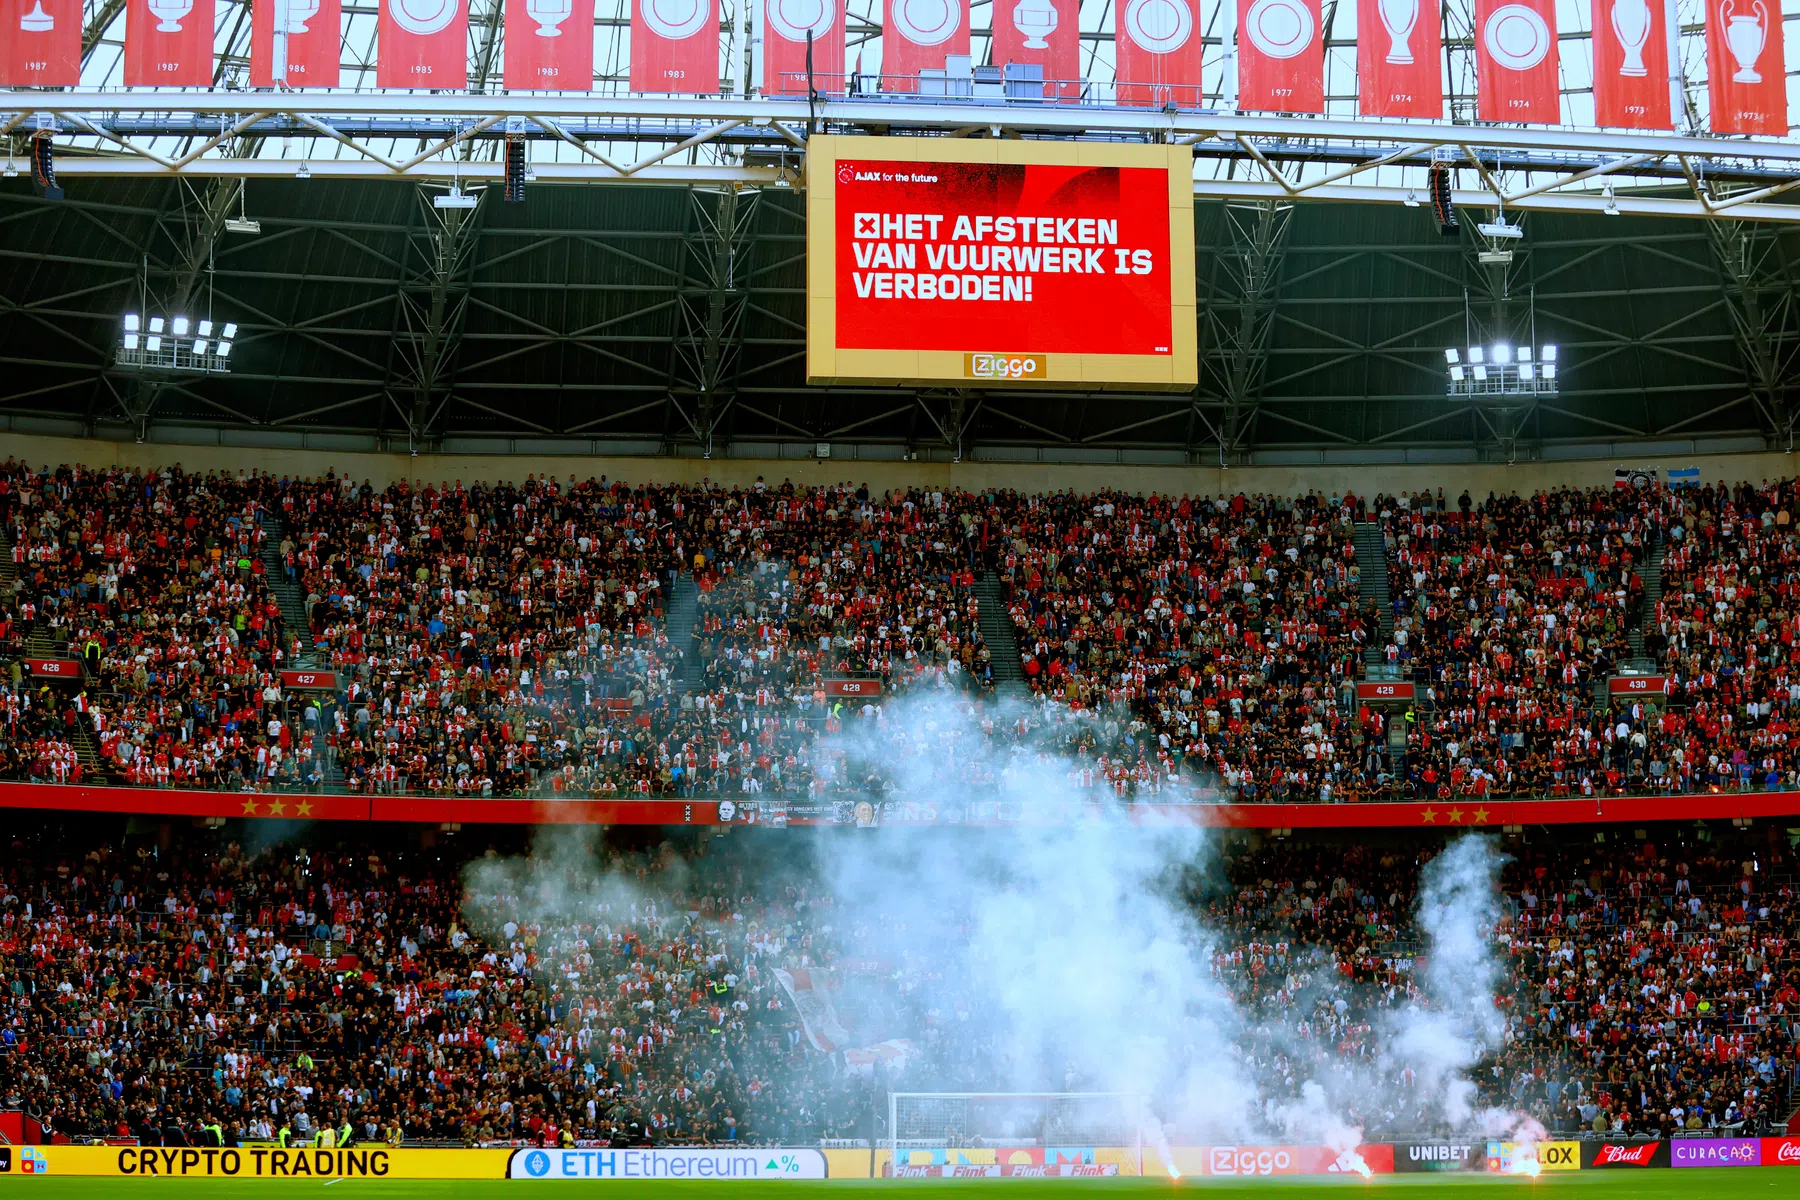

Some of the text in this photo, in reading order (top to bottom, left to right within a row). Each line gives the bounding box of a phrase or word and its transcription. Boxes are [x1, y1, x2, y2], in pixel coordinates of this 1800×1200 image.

[25, 62, 47, 70] 1987
[157, 63, 179, 71] 1987
[288, 65, 306, 73] 986
[537, 67, 559, 76] 1983
[663, 70, 685, 78] 1983
[1271, 88, 1292, 97] 1977
[1390, 94, 1412, 103] 1974
[1508, 99, 1530, 108] 1974
[1624, 106, 1645, 115] 1973
[855, 171, 880, 181] AJAX
[882, 172, 893, 181] for
[895, 173, 909, 182] the
[911, 173, 938, 183] future
[883, 213, 1117, 244] HET AFSTEKEN
[852, 242, 1152, 275] VAN VUURWERK IS
[852, 272, 1032, 302] VERBODEN!
[42, 663, 60, 672] 426
[297, 675, 315, 684] 427
[842, 683, 861, 692] 428
[1629, 680, 1647, 689] 430
[1376, 686, 1394, 695] 429
[1409, 1145, 1471, 1161] UNIBET
[1604, 1146, 1643, 1162] Bud
[118, 1149, 390, 1176] CRYPTO TRADING
[562, 1152, 616, 1176] ETH
[624, 1151, 758, 1176] Ethereum
[953, 1165, 987, 1177] Flink
[1011, 1165, 1047, 1177] Flink
[1070, 1165, 1105, 1177] Flink
